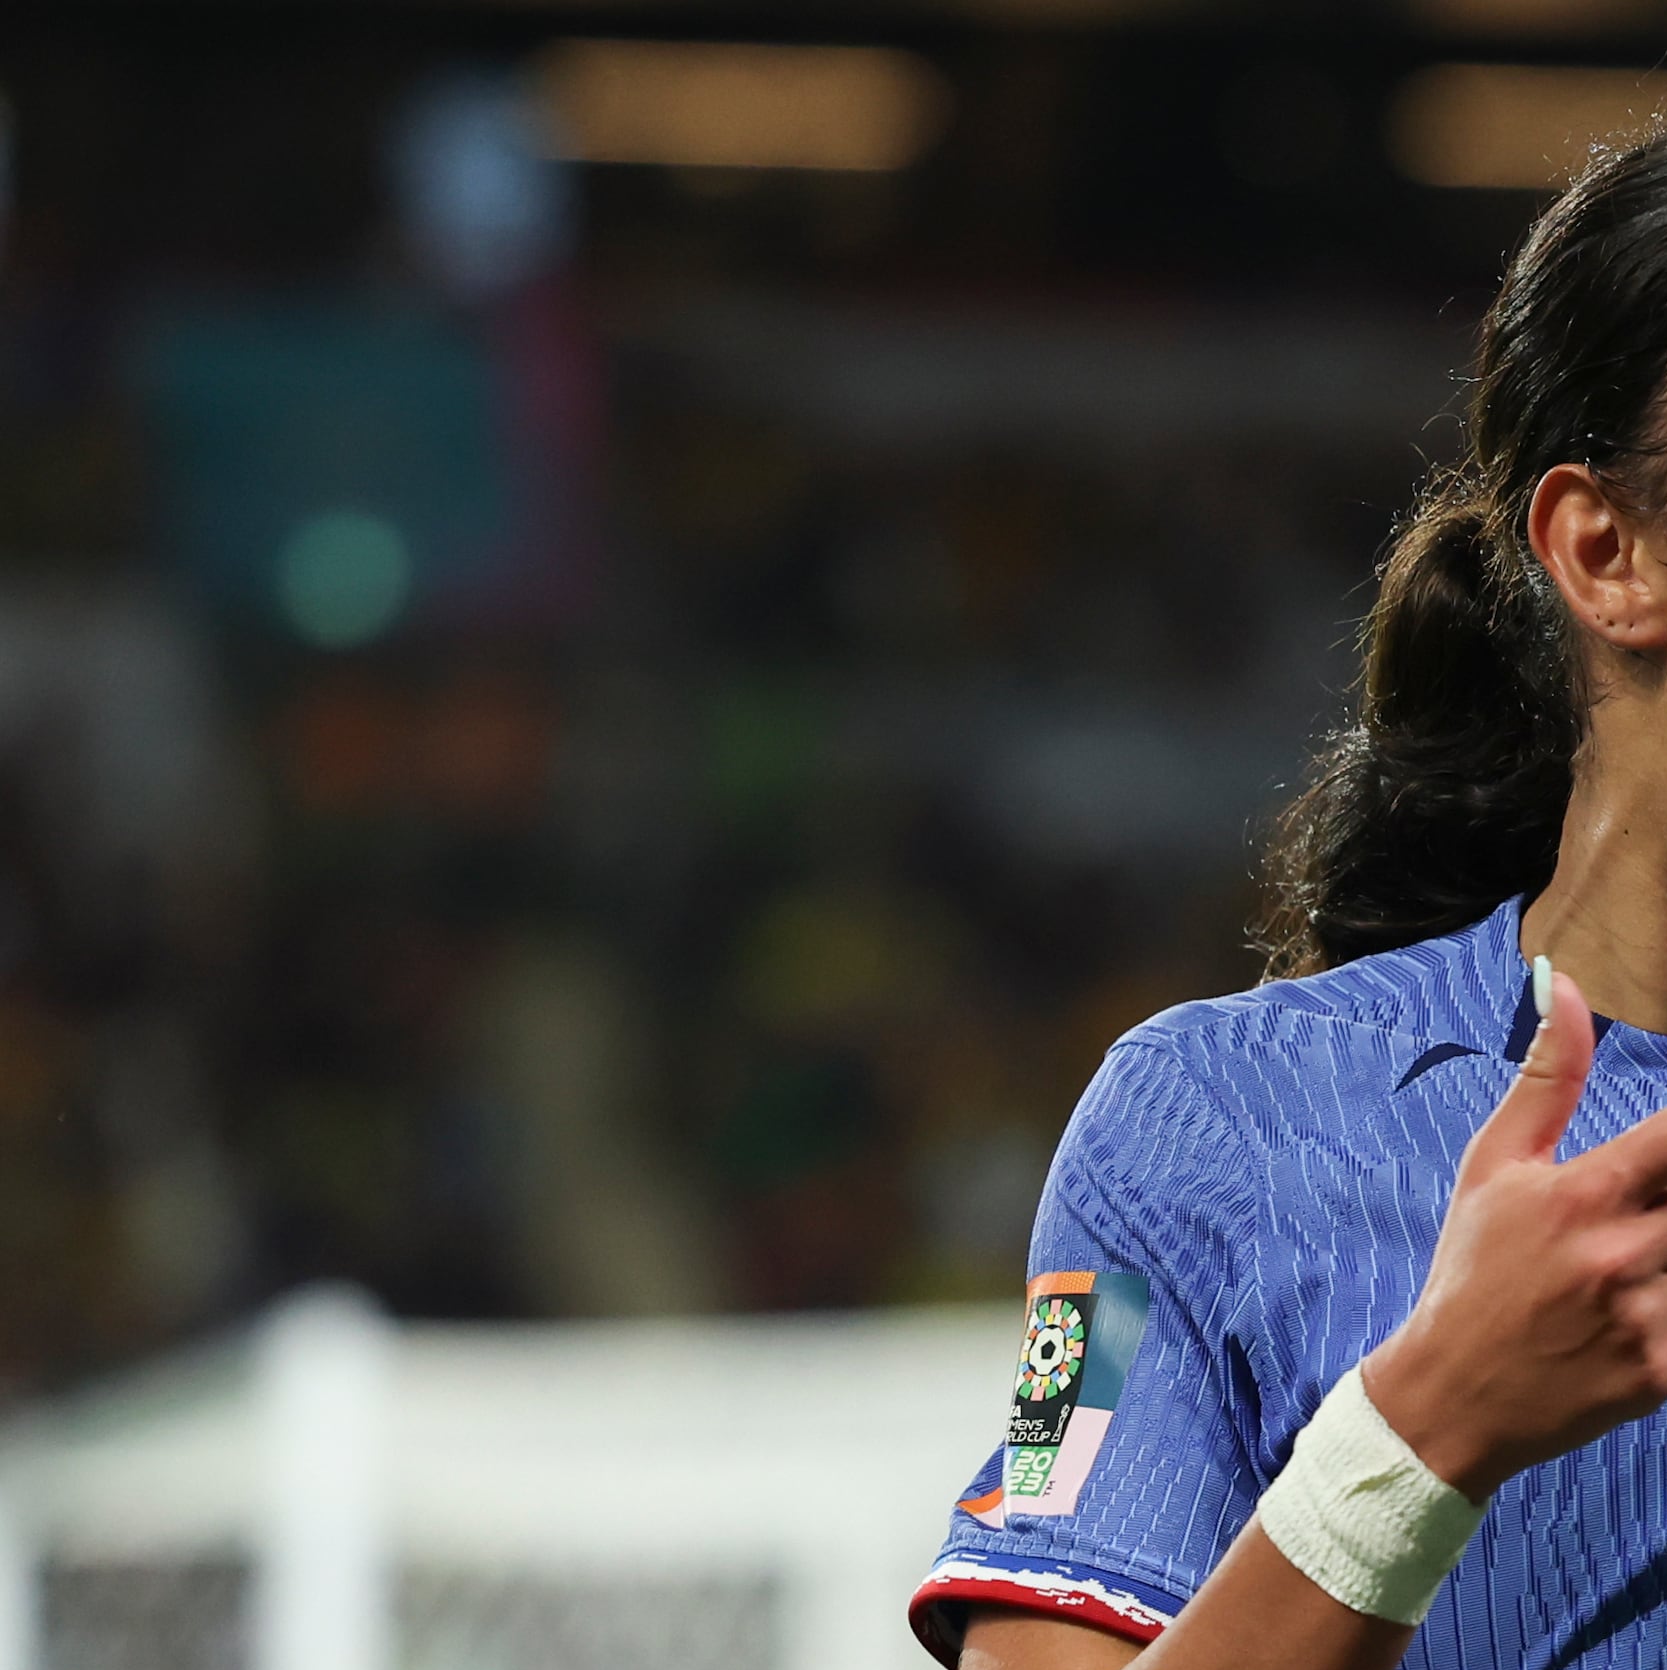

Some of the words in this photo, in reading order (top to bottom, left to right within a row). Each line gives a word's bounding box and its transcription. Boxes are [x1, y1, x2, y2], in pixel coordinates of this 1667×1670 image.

[1027, 1431, 1051, 1443] CUP
[1013, 1450, 1053, 1472] 20
[1006, 1471, 1044, 1492] 23
